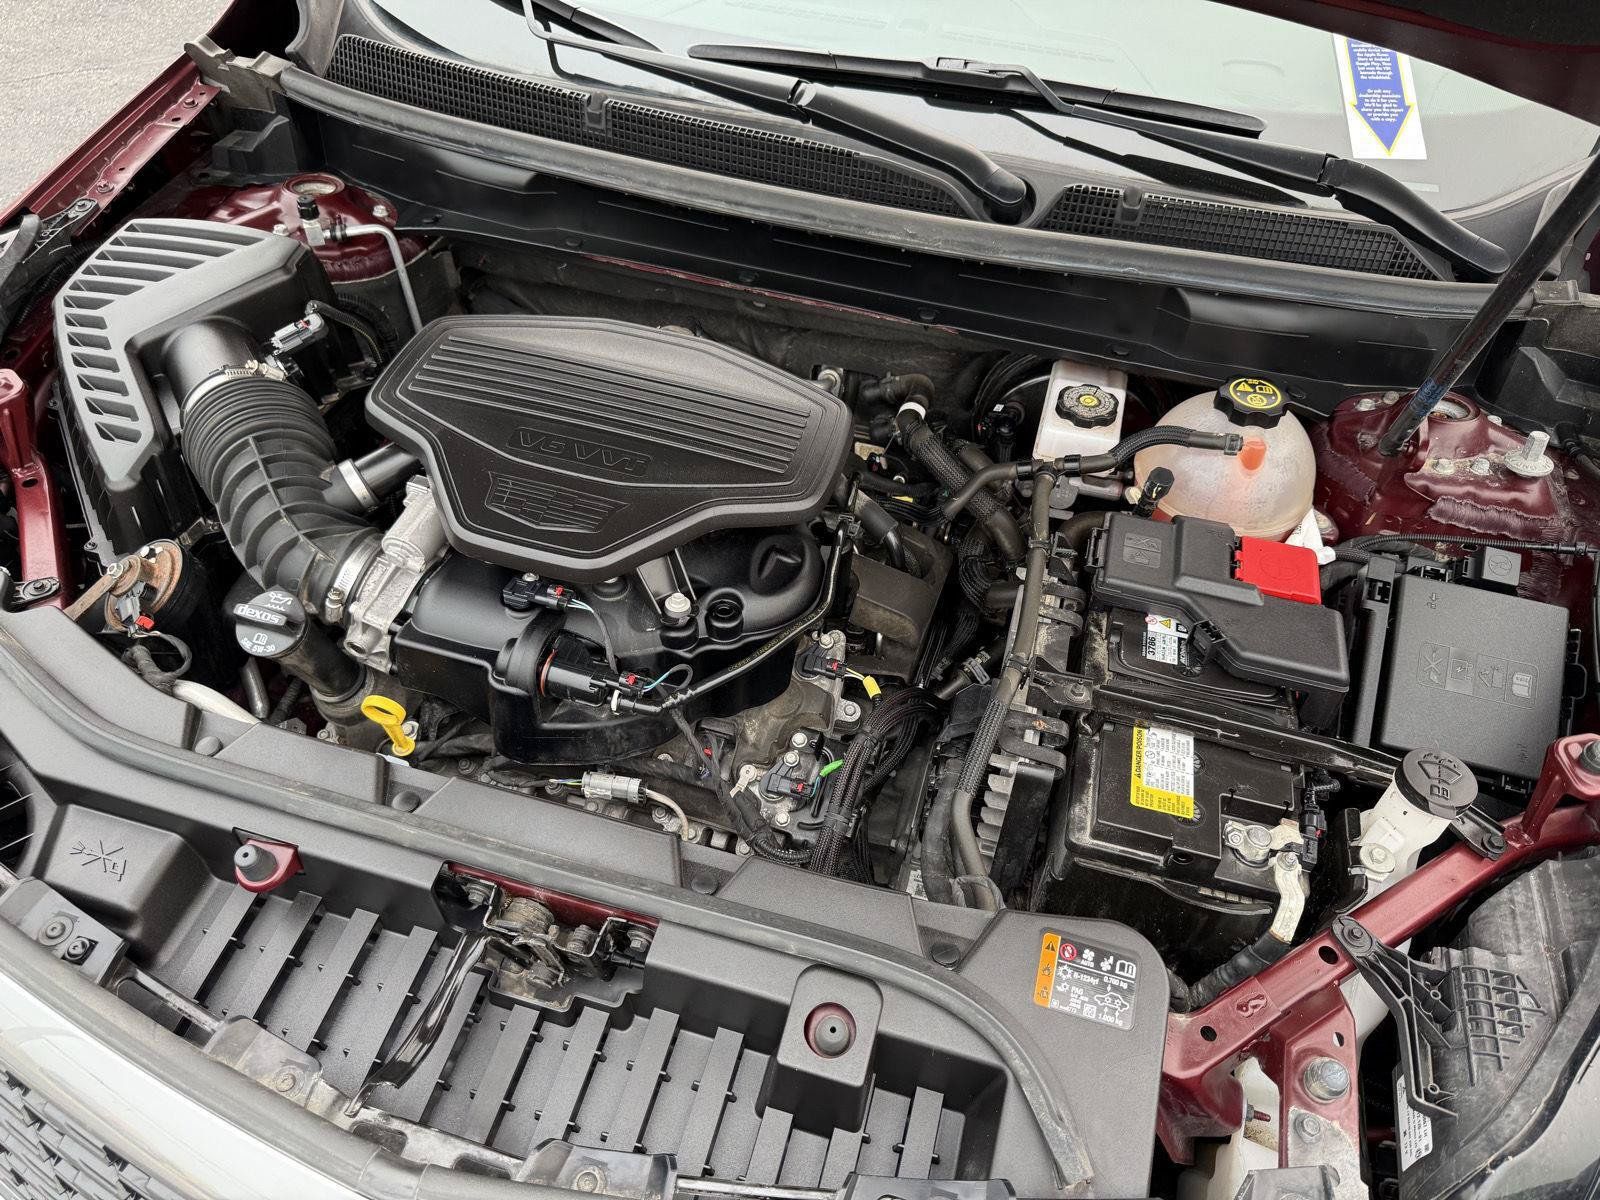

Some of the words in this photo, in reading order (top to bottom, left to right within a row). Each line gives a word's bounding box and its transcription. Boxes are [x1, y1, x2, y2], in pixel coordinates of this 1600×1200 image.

[520, 431, 566, 454] V6
[574, 443, 646, 471] VVT
[237, 605, 280, 624] dexos
[241, 638, 253, 650] SAE
[252, 644, 276, 653] 5W-30
[1148, 636, 1156, 656] 3786
[1081, 959, 1094, 967] AUTO
[1073, 972, 1099, 985] R-1234yf
[1104, 976, 1119, 985] 0.700
[1120, 980, 1128, 989] kg
[1071, 986, 1084, 995] PAG
[1115, 1018, 1123, 1026] kg
